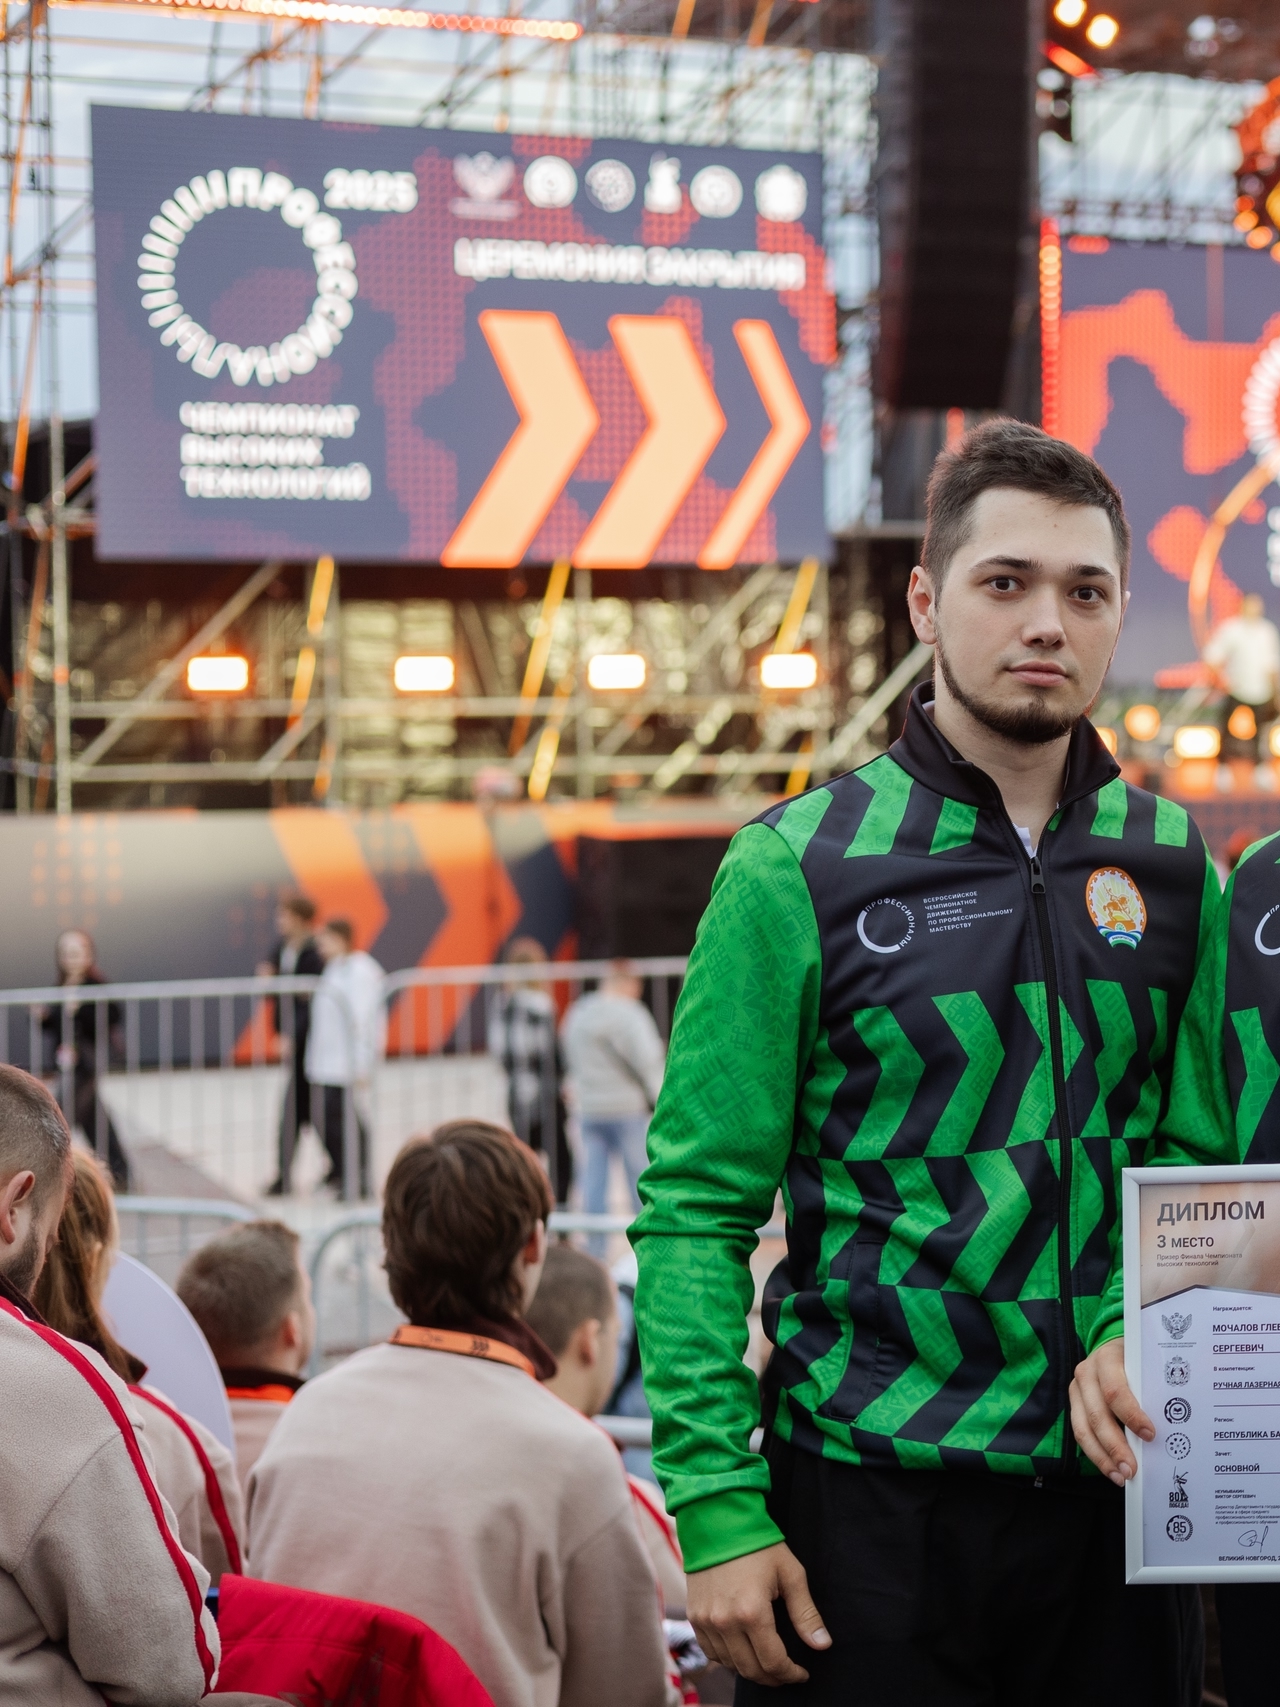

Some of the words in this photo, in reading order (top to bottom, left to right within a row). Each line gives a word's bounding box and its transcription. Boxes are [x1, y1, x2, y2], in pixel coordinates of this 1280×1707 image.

[323, 168, 418, 212] 2025
[923, 891, 978, 904] ВСЕРОССИЙСКОЕ
[924, 898, 977, 910] ЧЕМПИОНАТНОЕ
[926, 908, 963, 919] ДВИЖЕНИЕ
[938, 908, 1014, 924] ПРОФЕССИОНАЛЬНОМУ
[865, 897, 915, 947] ПРОФЕССИОНАЛЫ
[930, 922, 972, 933] МАСТЕРСТВУ
[1157, 1201, 1265, 1226] ДИПЛОМ
[1157, 1235, 1166, 1248] 3
[1172, 1236, 1214, 1248] МЕСТО
[1213, 1324, 1258, 1332] МОЧАЛОВ
[1213, 1344, 1264, 1352] СЕРГЕЕВИЧ
[1214, 1431, 1268, 1439] РЕСПУБЛИКА
[1214, 1463, 1260, 1472] ОСНОВНОЙ
[1173, 1522, 1186, 1534] 85
